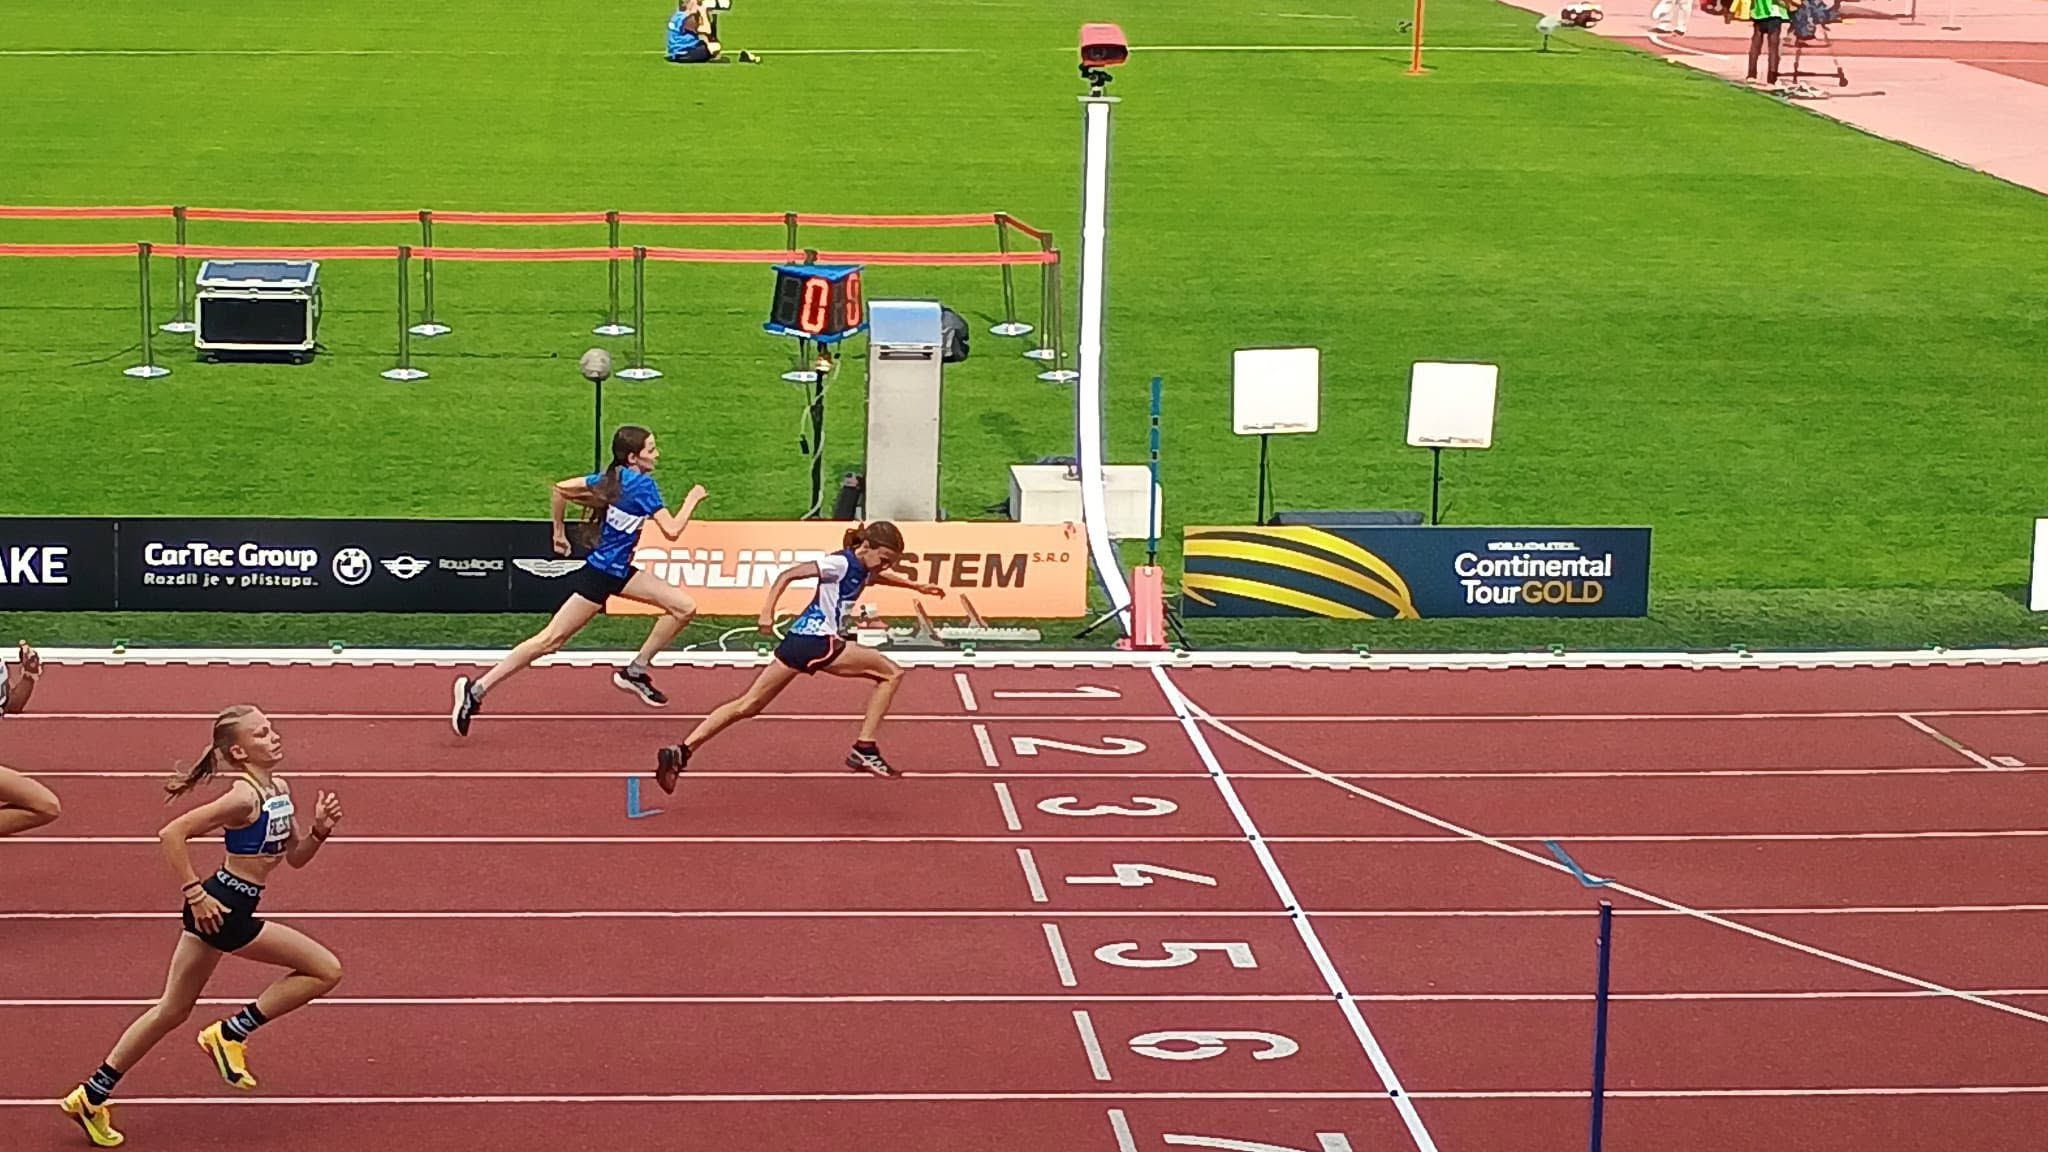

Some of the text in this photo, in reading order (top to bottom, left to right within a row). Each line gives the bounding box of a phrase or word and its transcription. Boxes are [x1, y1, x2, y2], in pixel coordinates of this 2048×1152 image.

[801, 278, 829, 333] 0
[0, 547, 68, 583] KE
[145, 543, 318, 571] CarTec Group
[1455, 552, 1612, 577] Continental
[203, 573, 220, 588] je
[226, 576, 236, 586] v
[994, 686, 1121, 698] 1
[1011, 736, 1147, 756] 2
[1037, 796, 1178, 816] 3
[1065, 864, 1217, 886] 4
[1094, 942, 1258, 968] 5
[1129, 1030, 1299, 1060] 6
